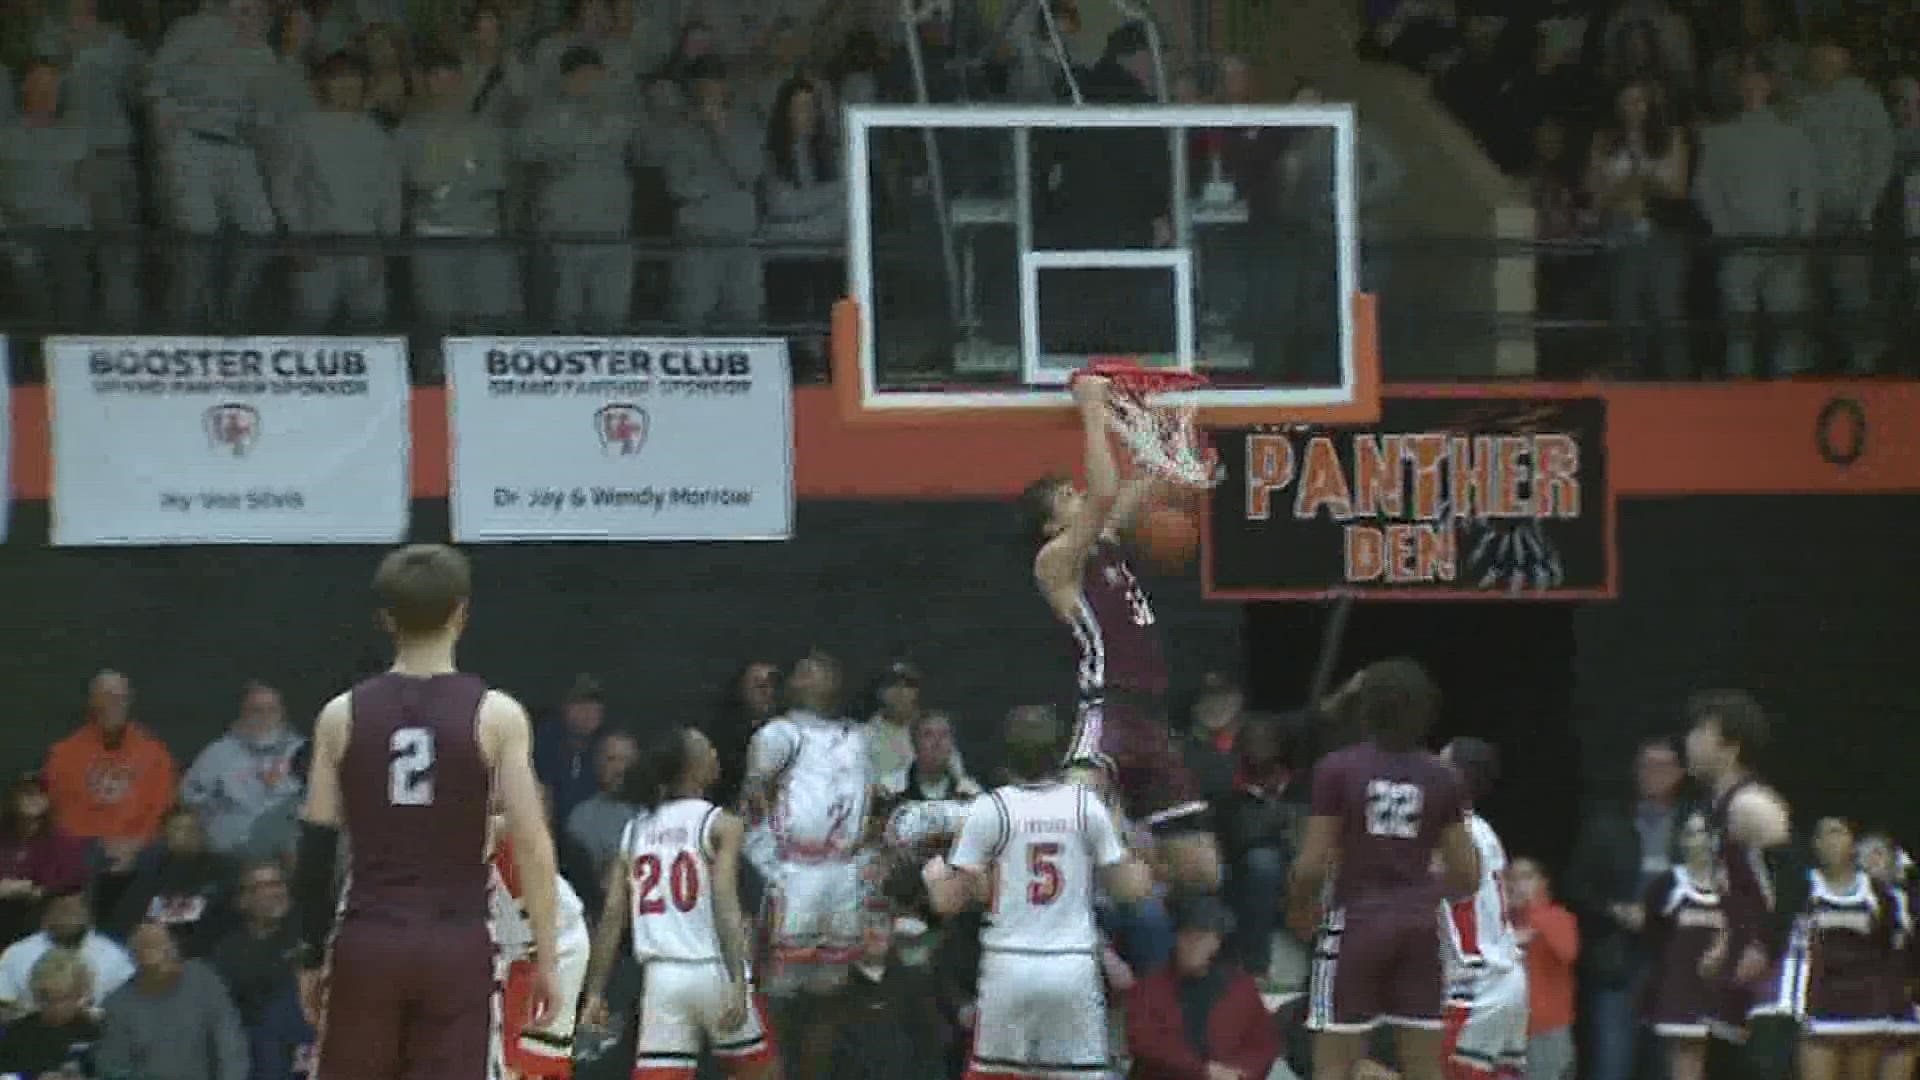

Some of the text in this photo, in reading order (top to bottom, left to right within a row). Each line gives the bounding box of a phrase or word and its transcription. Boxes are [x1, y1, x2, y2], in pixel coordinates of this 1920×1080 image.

[89, 349, 367, 377] BOOSTER CLUB
[486, 350, 750, 376] BOOSTER CLUB
[1245, 433, 1581, 520] PANTHER
[1344, 524, 1456, 582] DEN
[388, 728, 434, 806] 2
[1366, 780, 1422, 838] 22
[633, 851, 699, 915] 20
[1026, 842, 1065, 906] 5
